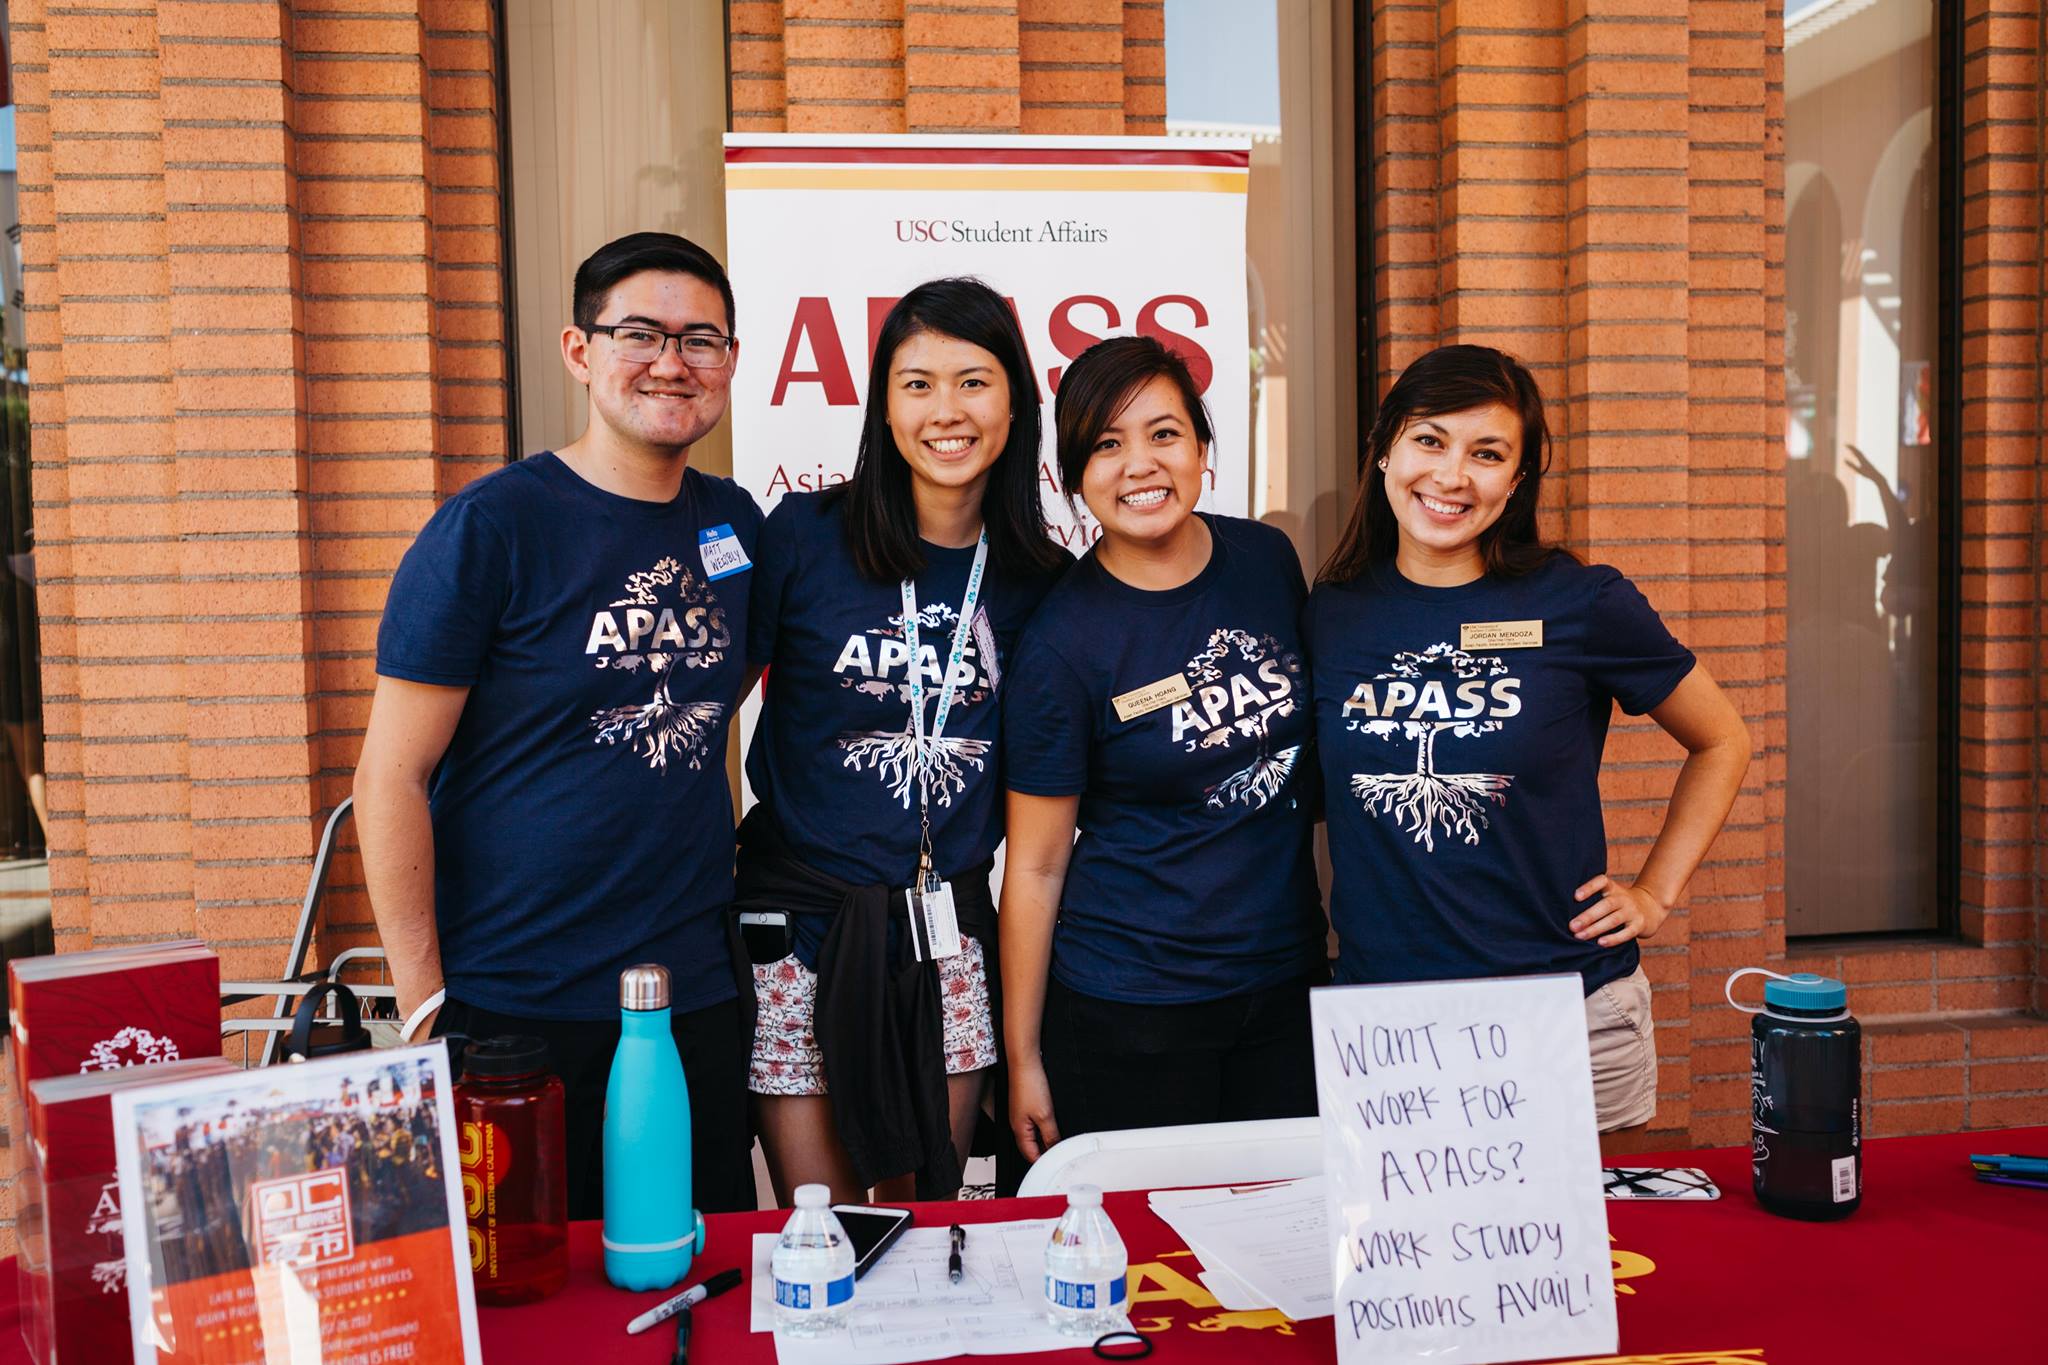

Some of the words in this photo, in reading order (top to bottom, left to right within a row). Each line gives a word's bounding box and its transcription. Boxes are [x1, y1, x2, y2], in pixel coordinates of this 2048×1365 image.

[895, 220, 948, 242] USC
[952, 219, 1033, 242] Student
[1039, 219, 1108, 242] Affairs
[770, 294, 1213, 406] ASS
[704, 542, 721, 559] MATT
[585, 606, 731, 654] APASS
[833, 634, 990, 687] APAS
[1128, 695, 1153, 708] QUEENA
[1154, 686, 1177, 698] HOANG
[1172, 655, 1301, 742] APAS
[1342, 677, 1522, 719] APASS
[1458, 1022, 1507, 1060] TO
[1357, 1086, 1440, 1130] WORK
[1459, 1080, 1526, 1127] FOR
[485, 1122, 495, 1171] CALIFORNIA
[487, 1171, 496, 1216] SOUTHERN
[1381, 1142, 1523, 1201] APASS?
[488, 1217, 496, 1228] OF
[488, 1229, 498, 1278] UNIVERSITY
[1348, 1230, 1432, 1273] WORK
